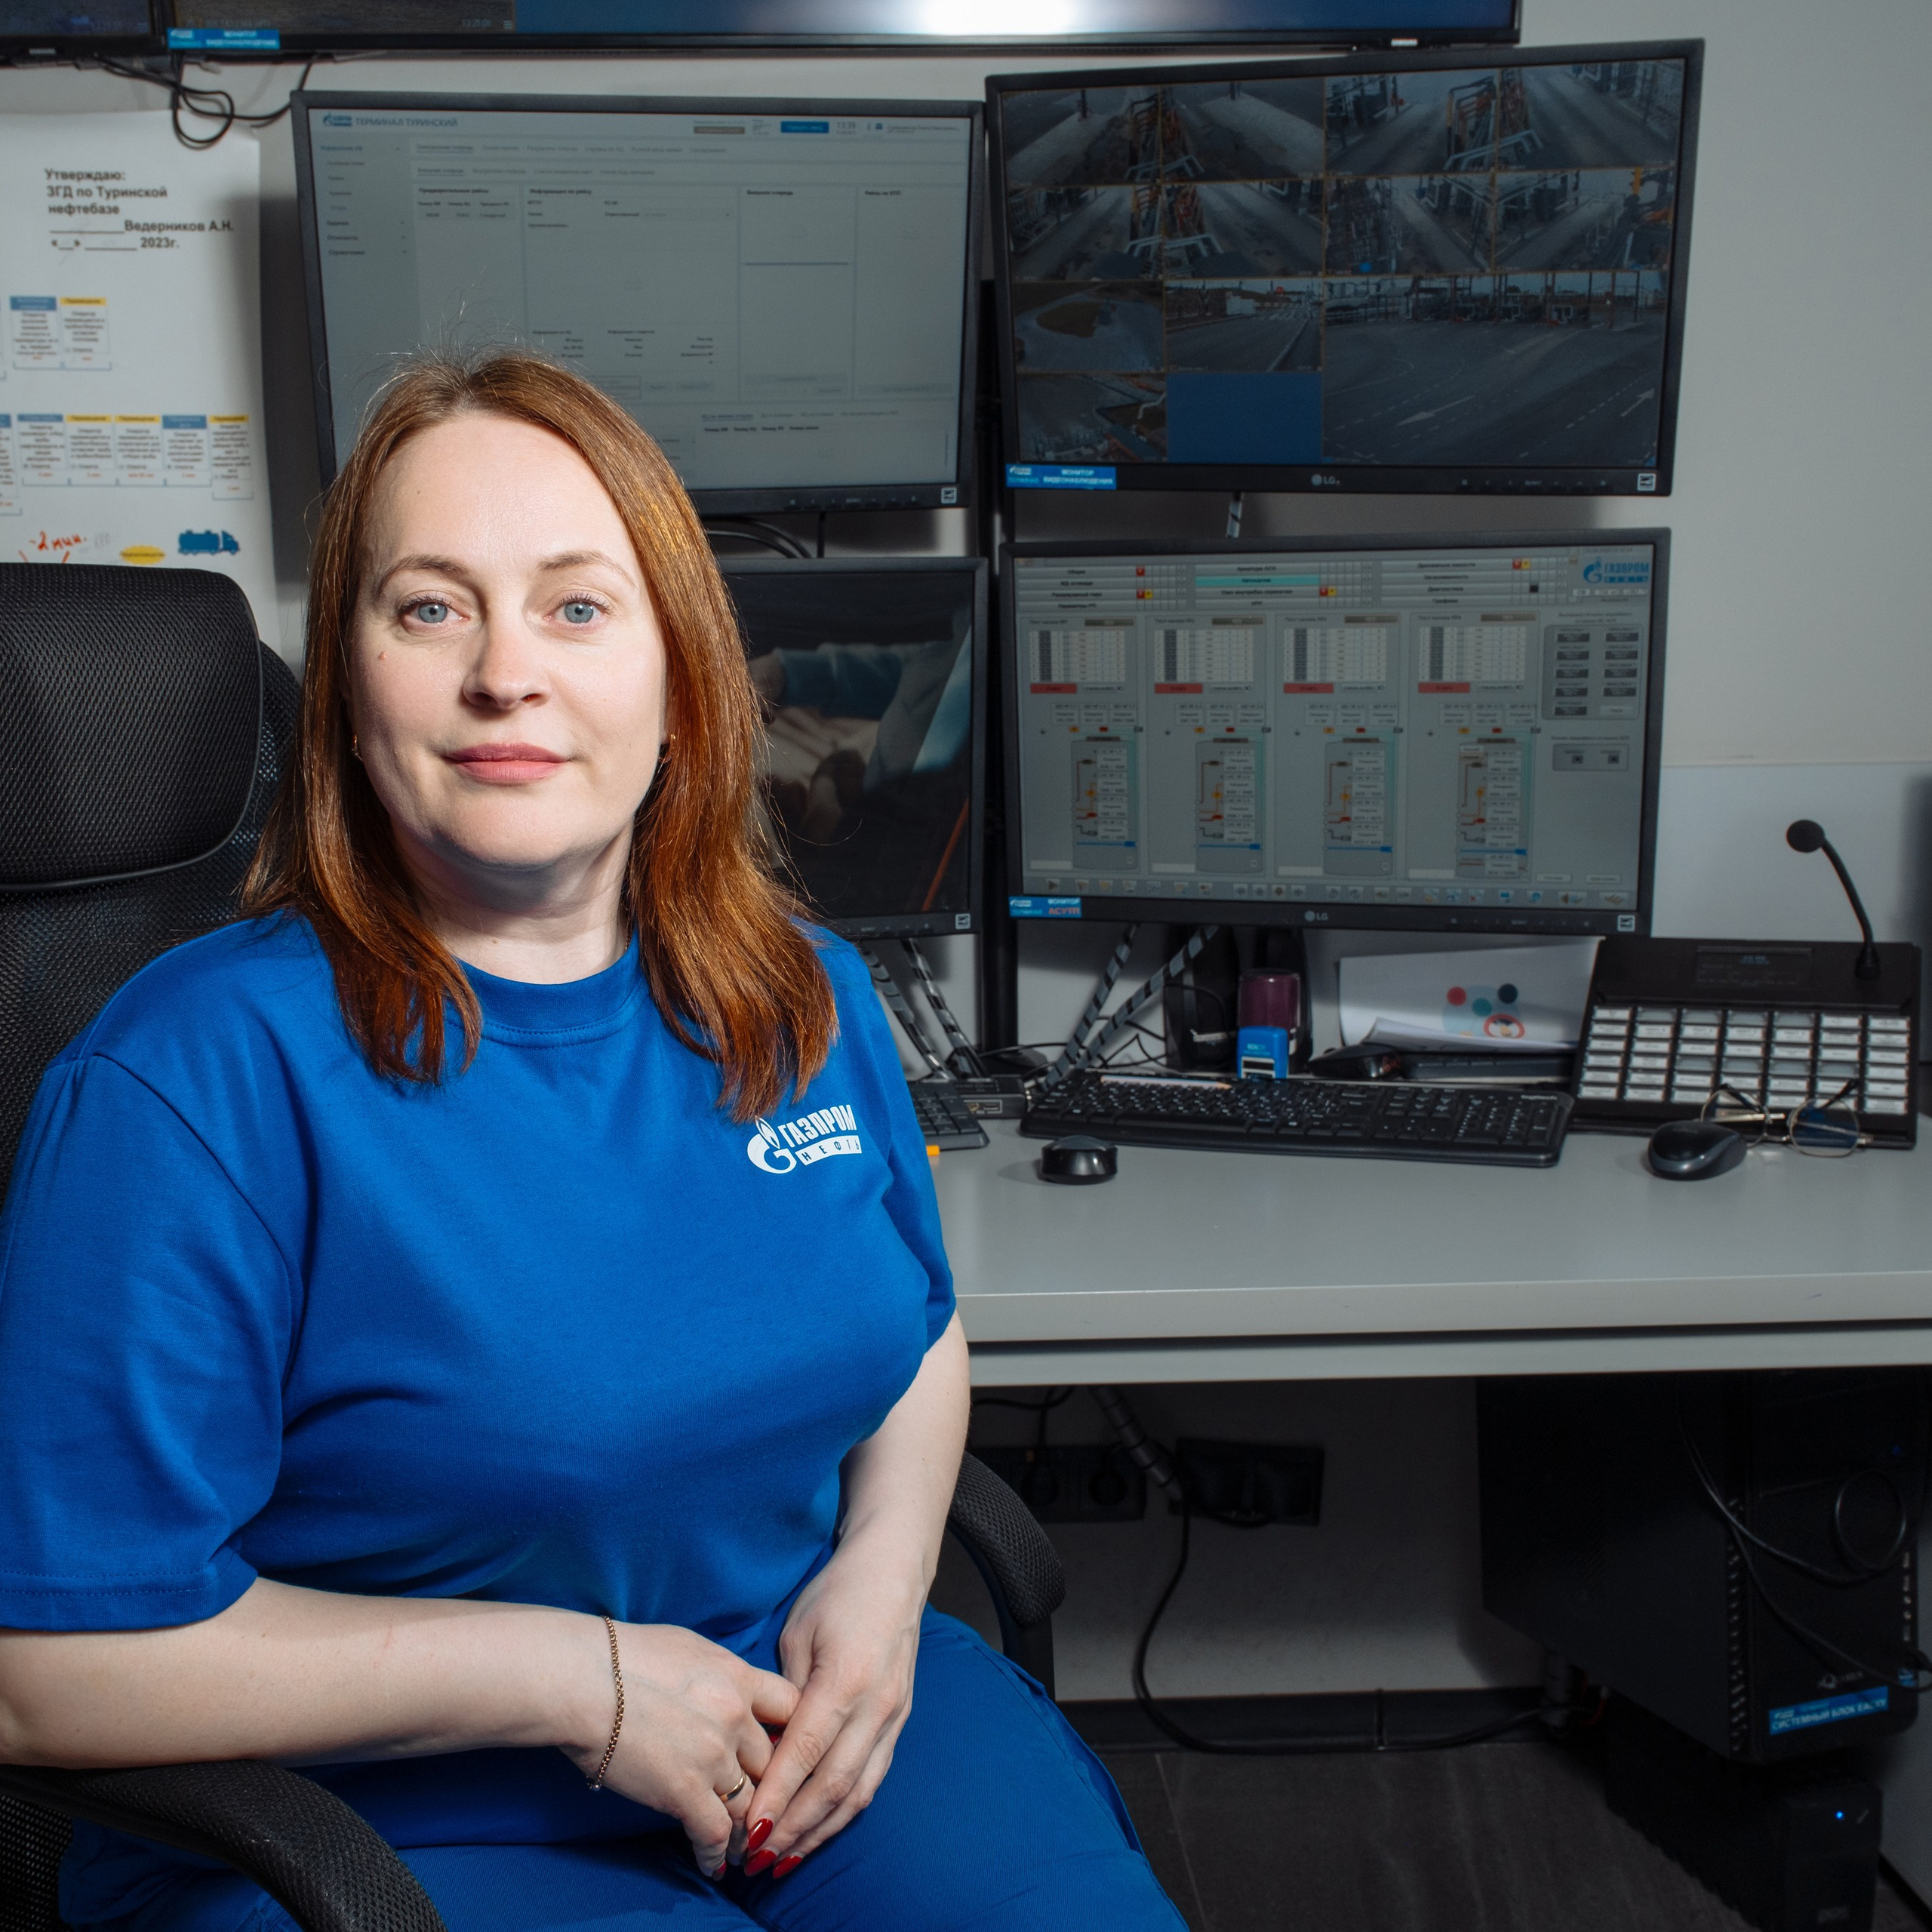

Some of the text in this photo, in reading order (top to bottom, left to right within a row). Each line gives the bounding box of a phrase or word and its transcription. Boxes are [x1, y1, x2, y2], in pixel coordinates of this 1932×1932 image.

[355, 116, 458, 128] ТЕРМИНАЛ ТУРИНСКИЙ
[45, 168, 126, 183] Утверждаю:
[47, 186, 168, 200] ЗГД по Туринской
[48, 203, 120, 216] нефтебазе
[209, 220, 234, 232] А.Н.
[140, 237, 180, 249] 2023г.
[1604, 562, 1649, 574] ГАЗПРОМ
[777, 1104, 857, 1148] ГАЗПРОМ
[801, 1139, 860, 1161] НЕФТЬ
[1772, 1710, 1830, 1730] СИСТЕМНЫЙ
[1831, 1706, 1856, 1718] БЛОК
